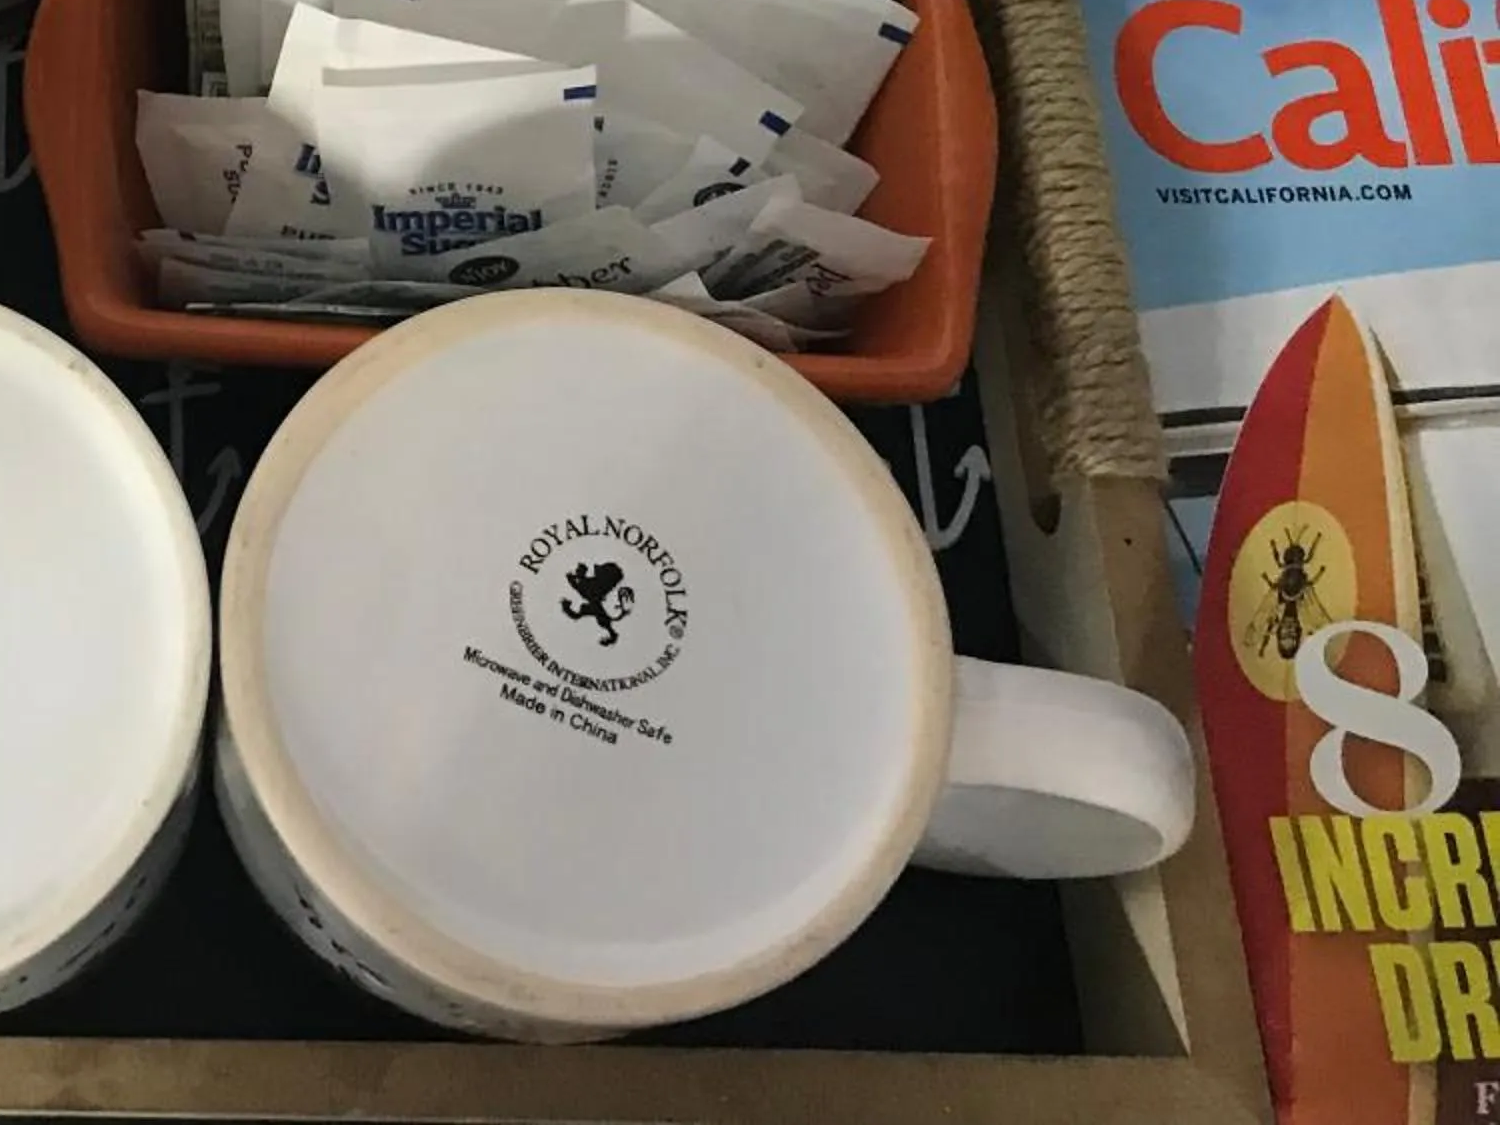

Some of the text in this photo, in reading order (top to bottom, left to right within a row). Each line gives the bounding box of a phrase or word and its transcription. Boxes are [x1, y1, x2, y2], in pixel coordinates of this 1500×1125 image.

[409, 182, 456, 195] SINCE
[1156, 183, 1412, 204] VISITCALIFORNIA.COM
[372, 205, 543, 237] Imperial
[518, 514, 600, 575] ROYAL
[463, 646, 673, 745] Microwave and Dishwasher Safe
[499, 683, 618, 745] Made in China
[1294, 619, 1462, 818] 8
